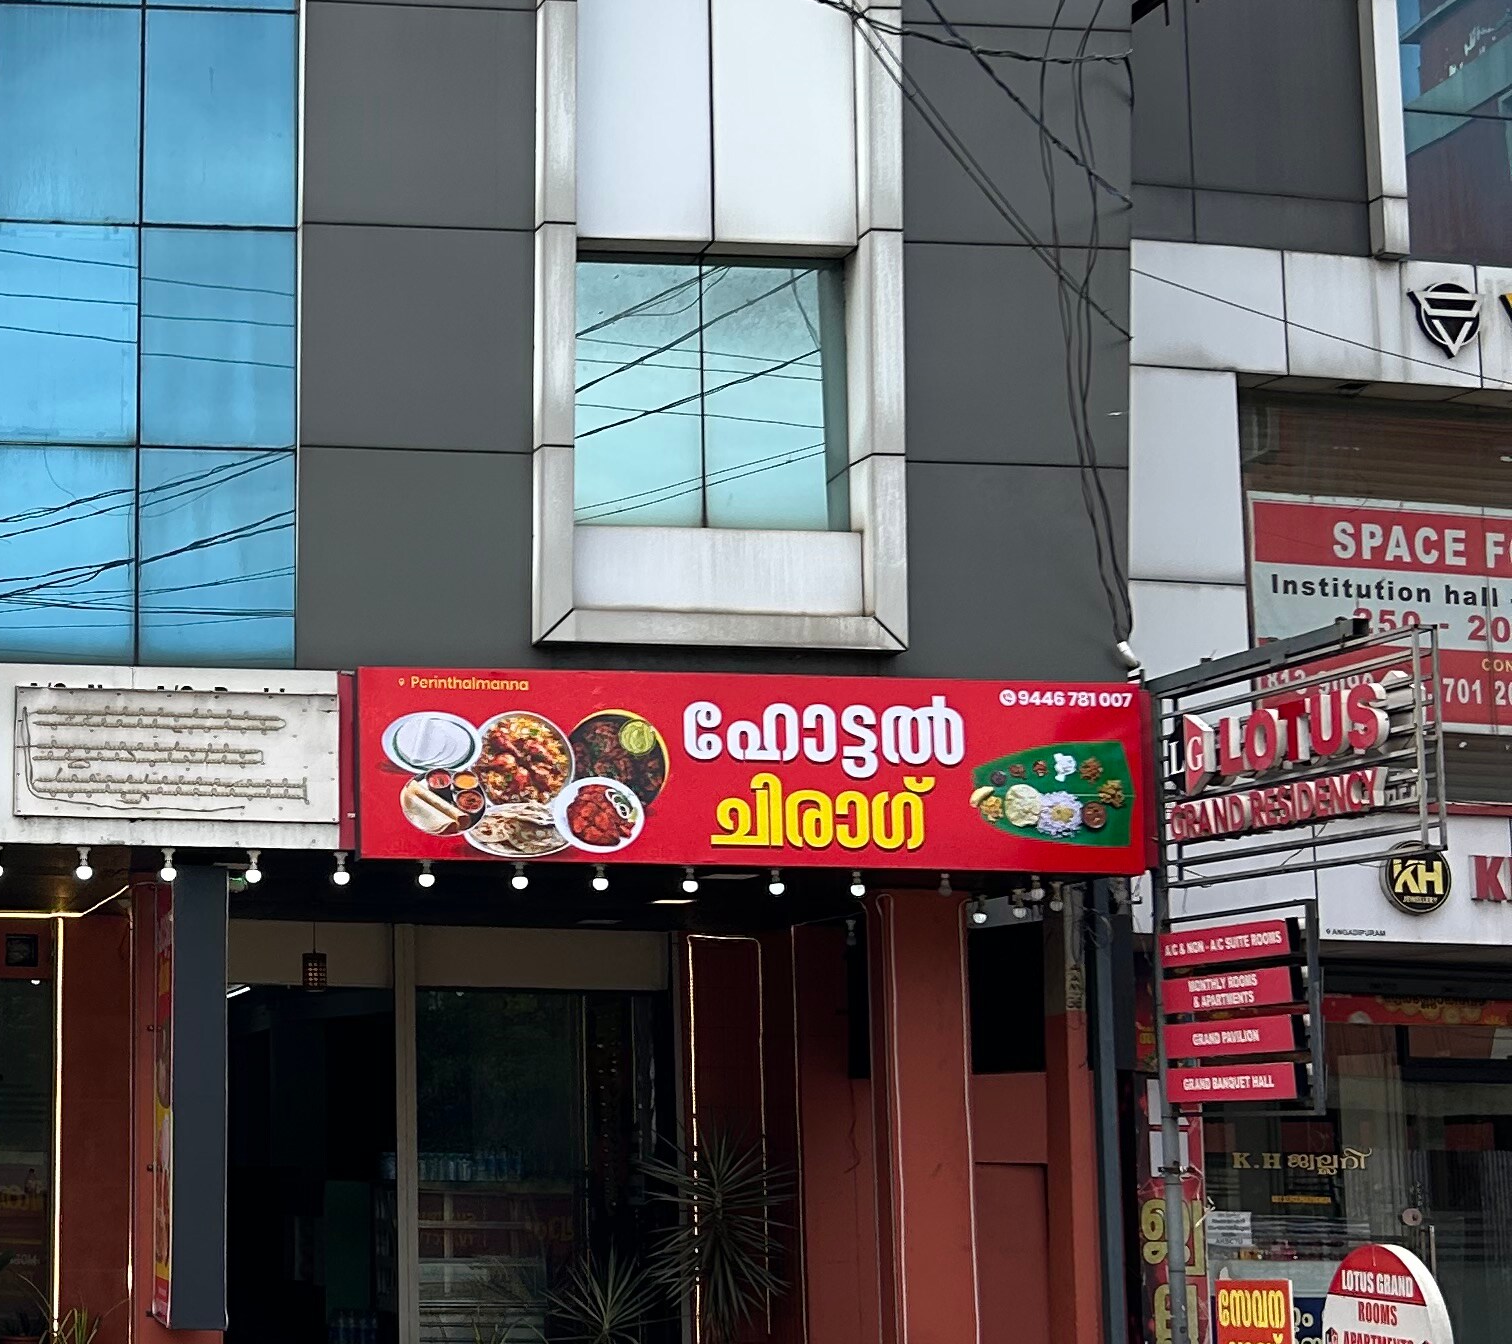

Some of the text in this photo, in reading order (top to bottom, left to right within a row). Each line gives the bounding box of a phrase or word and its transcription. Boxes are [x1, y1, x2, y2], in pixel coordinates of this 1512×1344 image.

[1333, 521, 1512, 569] SPACE F
[1271, 573, 1498, 607] Institution hall
[410, 675, 530, 692] Perinthalmanna
[1017, 690, 1133, 707] 9446 781 007
[683, 695, 965, 779] ഹോട്ടൽ
[1219, 682, 1380, 776] LOTUS
[709, 773, 936, 852] ചിരാഗ്
[1170, 768, 1379, 840] GRAND RESIDENCY
[1392, 859, 1444, 895] KH
[1472, 856, 1512, 903] K
[1228, 974, 1258, 988] ROOMS
[1252, 1074, 1275, 1088] HALL
[1341, 1269, 1414, 1298] LOTUS GRAND
[1218, 1289, 1286, 1329] സേവന
[1358, 1301, 1398, 1327] ROOMS
